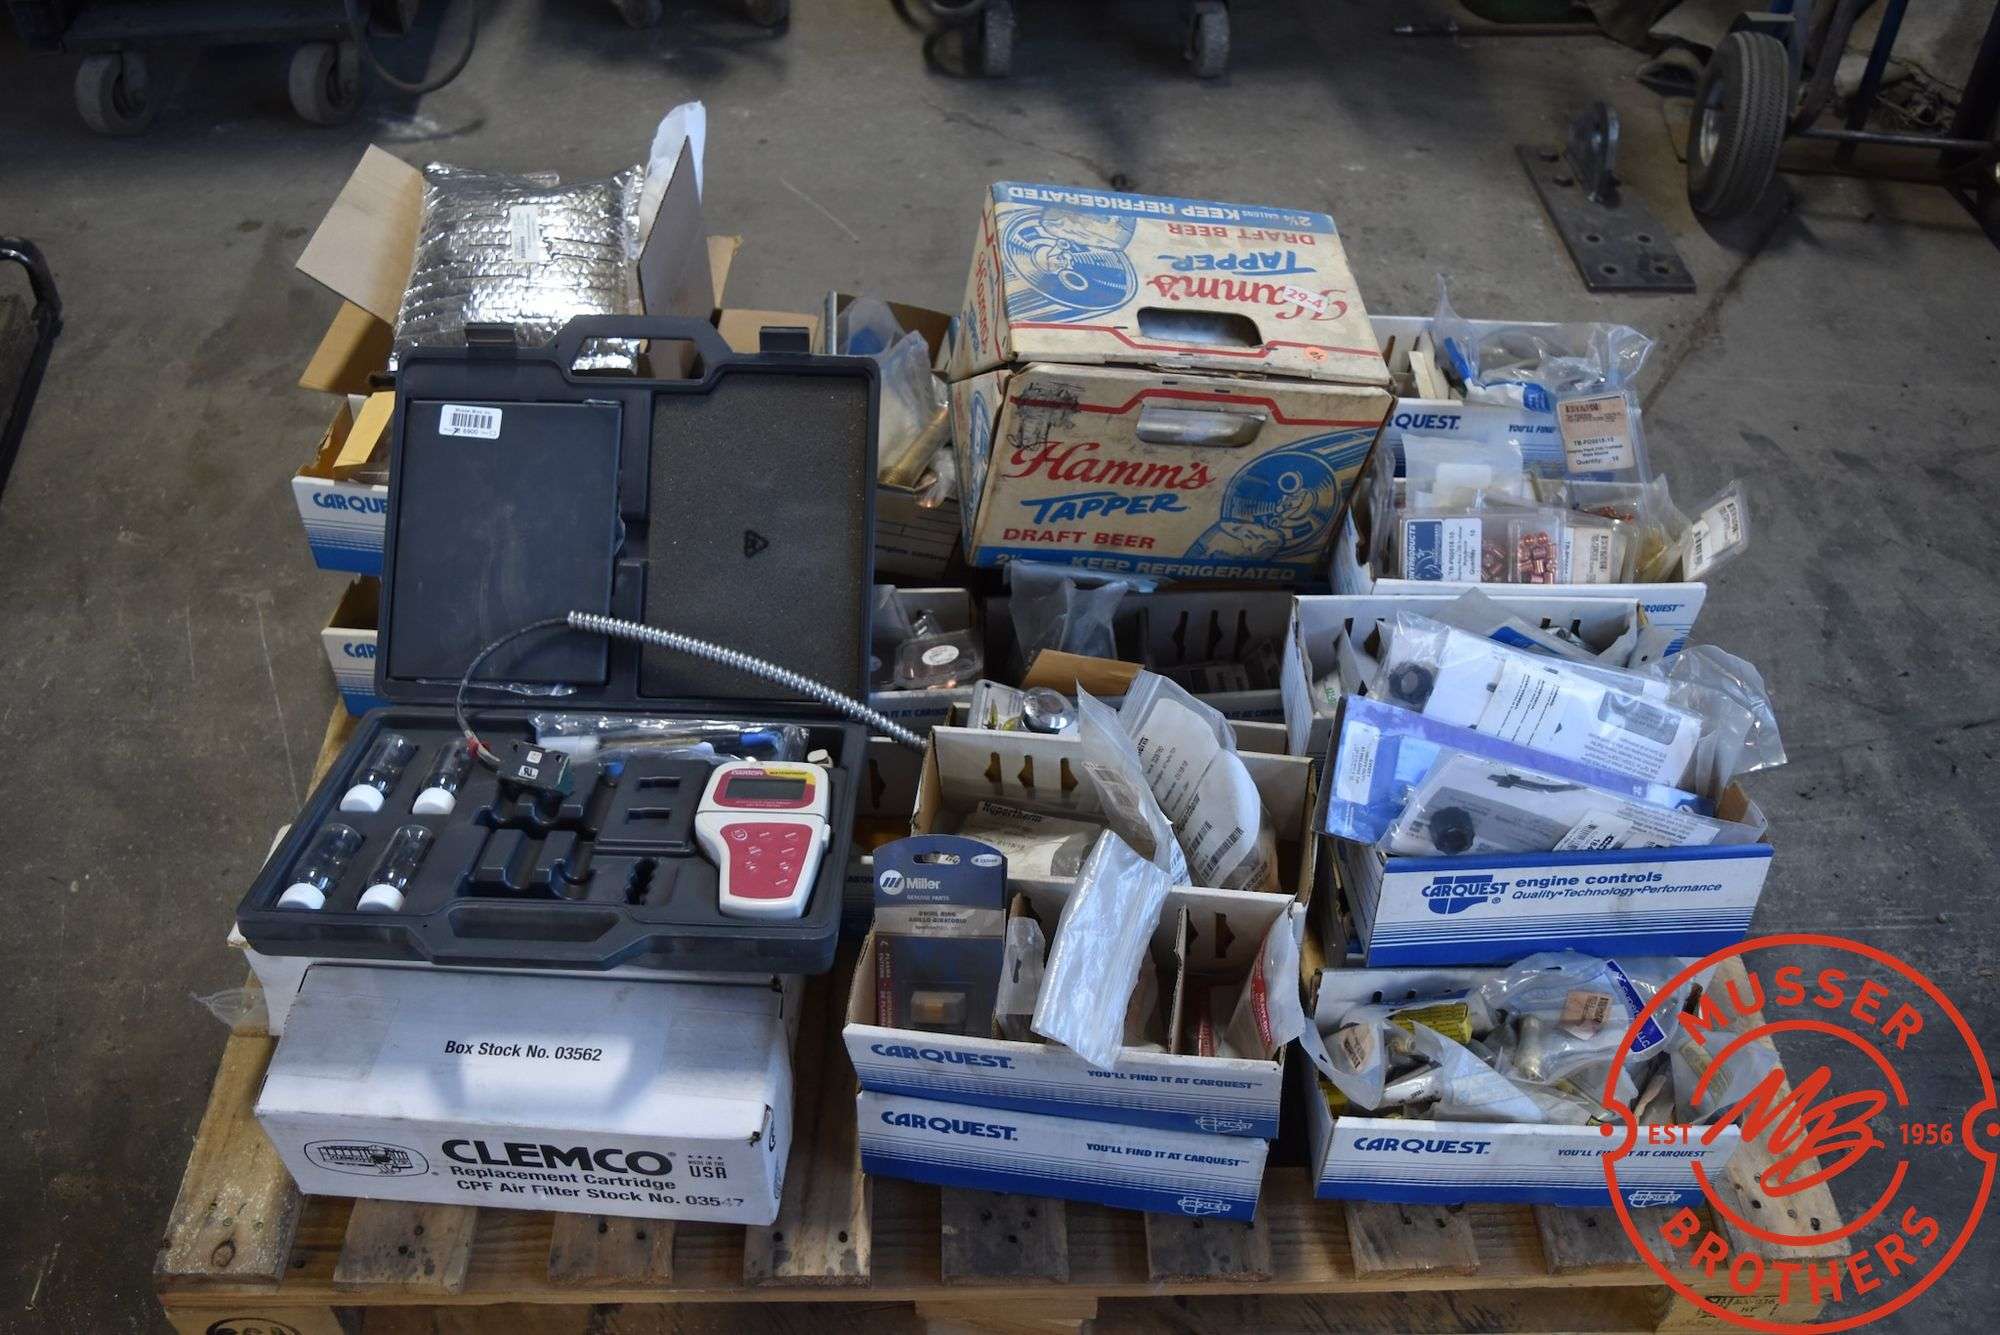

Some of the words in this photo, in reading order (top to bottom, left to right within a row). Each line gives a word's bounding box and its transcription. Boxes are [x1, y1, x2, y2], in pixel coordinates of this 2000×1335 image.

[1008, 186, 1175, 215] REFRIGERATED
[1181, 205, 1240, 221] KEEP
[1168, 222, 1228, 239] BEER
[1236, 228, 1316, 246] DRAFT
[1157, 250, 1317, 276] TAPPER
[1387, 413, 1462, 431] QUEST.
[1002, 441, 1217, 490] Hamm's
[313, 491, 388, 515] CARQUE
[1020, 491, 1190, 525] TAPPER
[1003, 527, 1087, 545] DRAFT
[1094, 531, 1156, 550] BEER
[1071, 556, 1131, 573] KEEP
[1135, 563, 1297, 581] REFRIGERATED
[1643, 604, 1678, 613] RQUEST
[907, 877, 941, 890] Miller
[1421, 881, 1510, 899] CARQUEST
[1515, 875, 1579, 890] engine
[1584, 871, 1663, 886] controls
[445, 1040, 474, 1055] Box
[478, 1042, 521, 1057] Stock
[526, 1045, 550, 1059] No.
[555, 1046, 603, 1061] 03562
[1087, 1070, 1125, 1082] YOU'LL
[1130, 1072, 1158, 1083] FIND
[1161, 1075, 1172, 1083] IT
[1175, 1075, 1190, 1085] AT
[1193, 1078, 1253, 1090] CARQUEST
[442, 1139, 673, 1176] CLEMCO
[1087, 1142, 1123, 1155] YOU'LL
[1126, 1147, 1152, 1158] FIND
[1155, 1150, 1166, 1158] IT
[1167, 1152, 1183, 1161] AT
[1185, 1154, 1240, 1167] CARQUEST
[1558, 1149, 1592, 1157] YOU'LL
[1652, 1150, 1706, 1158] CARQUEST
[450, 1165, 577, 1184] Replacement
[584, 1173, 677, 1191] Cartridge
[689, 1165, 727, 1179] USA
[457, 1179, 492, 1192] CPF
[500, 1182, 525, 1194] Air
[532, 1184, 581, 1198] Filter
[587, 1188, 642, 1202] Stock
[648, 1192, 681, 1205] No.
